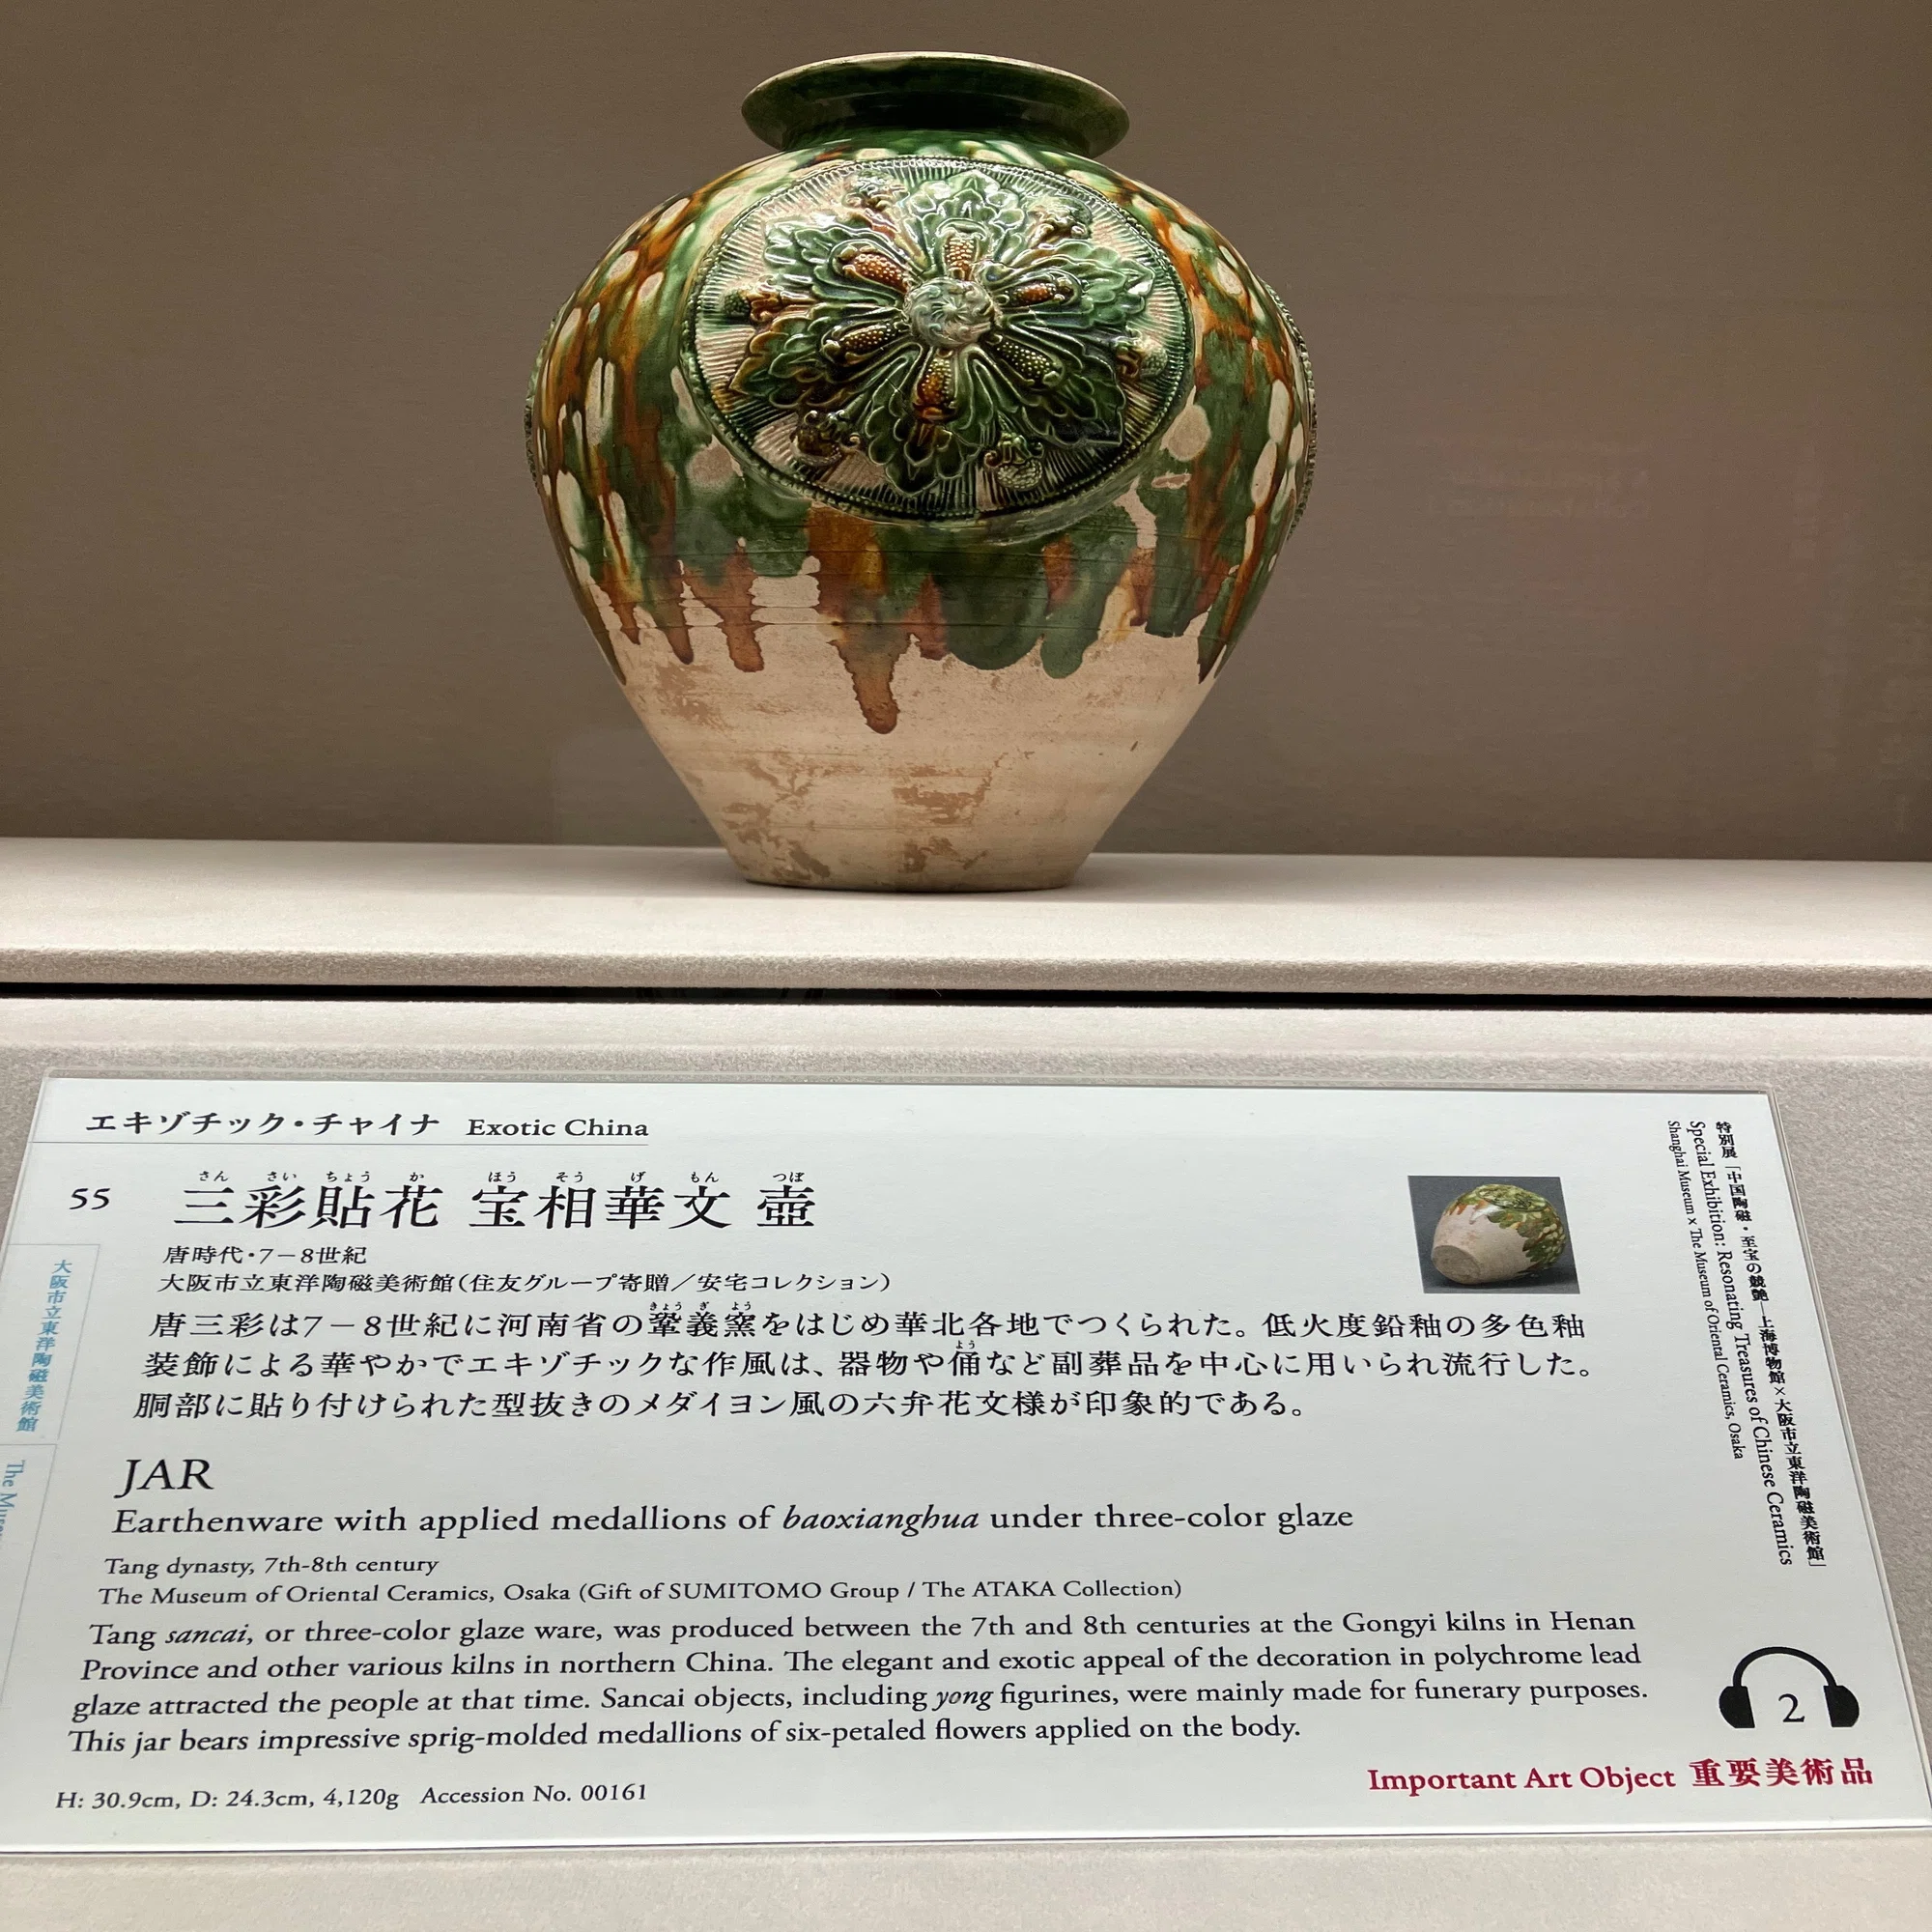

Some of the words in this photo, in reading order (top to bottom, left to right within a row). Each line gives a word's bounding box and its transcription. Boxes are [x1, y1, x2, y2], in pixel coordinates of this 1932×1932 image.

[465, 1118, 556, 1137] Exotic
[564, 1117, 650, 1137] China
[1667, 1121, 1689, 1168] Shanghai
[1686, 1121, 1716, 1167] Special
[68, 1187, 111, 1210] 55
[173, 1183, 444, 1232] 三彩貼花
[468, 1183, 733, 1231] 宝相華文
[1678, 1170, 1695, 1215] Museum
[1700, 1170, 1726, 1246] Exhibition:
[1690, 1228, 1704, 1249] The
[1694, 1251, 1712, 1297] Museum
[1717, 1251, 1745, 1330] Resonating
[1704, 1299, 1719, 1314] of
[1707, 1315, 1729, 1361] Oriental
[1734, 1333, 1758, 1404] Treasures
[1717, 1363, 1737, 1420] Ceramics,
[1748, 1406, 1769, 1425] of
[1728, 1423, 1747, 1460] Osaka
[1752, 1426, 1776, 1488] Chinese
[2, 1459, 26, 1488] The
[112, 1458, 215, 1500] JAR
[110, 1506, 324, 1534] Earthenware
[332, 1505, 408, 1532] with
[418, 1505, 540, 1540] applied
[550, 1504, 727, 1531] medallions
[737, 1503, 777, 1530] of
[781, 1503, 980, 1538] baoxianghua
[989, 1502, 1084, 1529] under
[1094, 1502, 1267, 1528] three-color
[1277, 1501, 1354, 1536] glaze
[1766, 1492, 1794, 1566] Ceramics
[103, 1557, 161, 1580] Tang
[165, 1555, 255, 1579] dynasty,
[264, 1554, 348, 1575] 7th-8th
[355, 1559, 440, 1577] century
[98, 1586, 144, 1605] The
[149, 1586, 248, 1605] Museum
[255, 1584, 284, 1604] of
[285, 1583, 380, 1604] Oriental
[386, 1583, 496, 1604] Ceramics,
[502, 1581, 572, 1602] Osaka
[579, 1581, 633, 1604] (Gift
[639, 1581, 666, 1601] of
[668, 1581, 822, 1600] SUMITOMO
[829, 1581, 900, 1604] Group
[921, 1579, 966, 1599] The
[971, 1579, 1058, 1598] ATAKA
[1063, 1578, 1182, 1600] Collection)
[88, 1623, 158, 1652] Tang
[163, 1623, 254, 1646] sancai,
[264, 1628, 297, 1643] or
[304, 1618, 452, 1642] three-color
[458, 1617, 526, 1648] glaze
[533, 1625, 603, 1642] ware,
[612, 1623, 662, 1643] was
[668, 1614, 795, 1646] produced
[804, 1615, 912, 1638] between
[921, 1614, 962, 1637] the
[970, 1613, 1016, 1637] 7th
[1024, 1613, 1074, 1636] and
[1083, 1612, 1128, 1635] 8th
[1135, 1614, 1251, 1635] centuries
[1259, 1618, 1285, 1634] at
[1292, 1610, 1334, 1634] the
[1342, 1611, 1437, 1639] Gongyi
[1441, 1609, 1507, 1632] kilns
[1515, 1611, 1542, 1632] in
[1548, 1610, 1636, 1632] Henan
[79, 1659, 200, 1681] Province
[206, 1655, 259, 1680] and
[267, 1654, 340, 1678] other
[347, 1656, 443, 1677] various
[449, 1652, 516, 1676] kilns
[523, 1654, 551, 1675] in
[558, 1650, 676, 1674] northern
[685, 1649, 774, 1673] China.
[782, 1649, 835, 1672] The
[840, 1648, 934, 1679] elegant
[941, 1647, 991, 1671] and
[998, 1650, 1076, 1670] exotic
[1082, 1646, 1167, 1676] appeal
[1173, 1645, 1204, 1668] of
[1207, 1645, 1250, 1669] the
[1256, 1645, 1393, 1668] decoration
[1399, 1646, 1426, 1666] in
[1433, 1642, 1583, 1673] polychrome
[1588, 1639, 1642, 1664] lead
[71, 1692, 142, 1724] glaze
[148, 1690, 270, 1716] attracted
[277, 1690, 322, 1714] the
[327, 1688, 420, 1720] people
[426, 1693, 454, 1712] at
[461, 1687, 516, 1711] that
[523, 1689, 590, 1710] time.
[600, 1687, 686, 1709] Sancai
[694, 1684, 793, 1715] objects,
[802, 1683, 928, 1713] including
[930, 1690, 995, 1713] yong
[999, 1678, 1120, 1712] figurines,
[1125, 1684, 1188, 1703] were
[1195, 1679, 1286, 1709] mainly
[1292, 1677, 1363, 1702] made
[1368, 1678, 1407, 1701] for
[1413, 1676, 1522, 1706] funerary
[1528, 1675, 1648, 1707] purposes.
[1777, 1692, 1806, 1723] 2
[67, 1728, 127, 1752] This
[129, 1730, 173, 1760] jar
[179, 1727, 250, 1752] bears
[256, 1727, 401, 1757] impressive
[407, 1720, 588, 1755] sprig-molded
[596, 1719, 743, 1745] medallions
[750, 1719, 783, 1743] of
[784, 1714, 927, 1748] six-petaled
[934, 1717, 1027, 1741] flowers
[1035, 1715, 1132, 1747] applied
[1139, 1722, 1175, 1739] on
[1180, 1714, 1224, 1738] the
[1230, 1713, 1301, 1744] body.
[1366, 1769, 1518, 1798] Important
[1522, 1767, 1574, 1789] Art
[1578, 1765, 1677, 1796] Object
[1688, 1756, 1874, 1788] 重要美術品
[54, 1791, 85, 1809] H:
[91, 1791, 182, 1810] 30.9cm,
[188, 1790, 218, 1808] D:
[224, 1788, 315, 1809] 24.3cm,
[322, 1787, 401, 1811] 4,120g
[418, 1786, 526, 1804] Accession
[531, 1784, 572, 1803] No.
[580, 1782, 646, 1802] 00161
